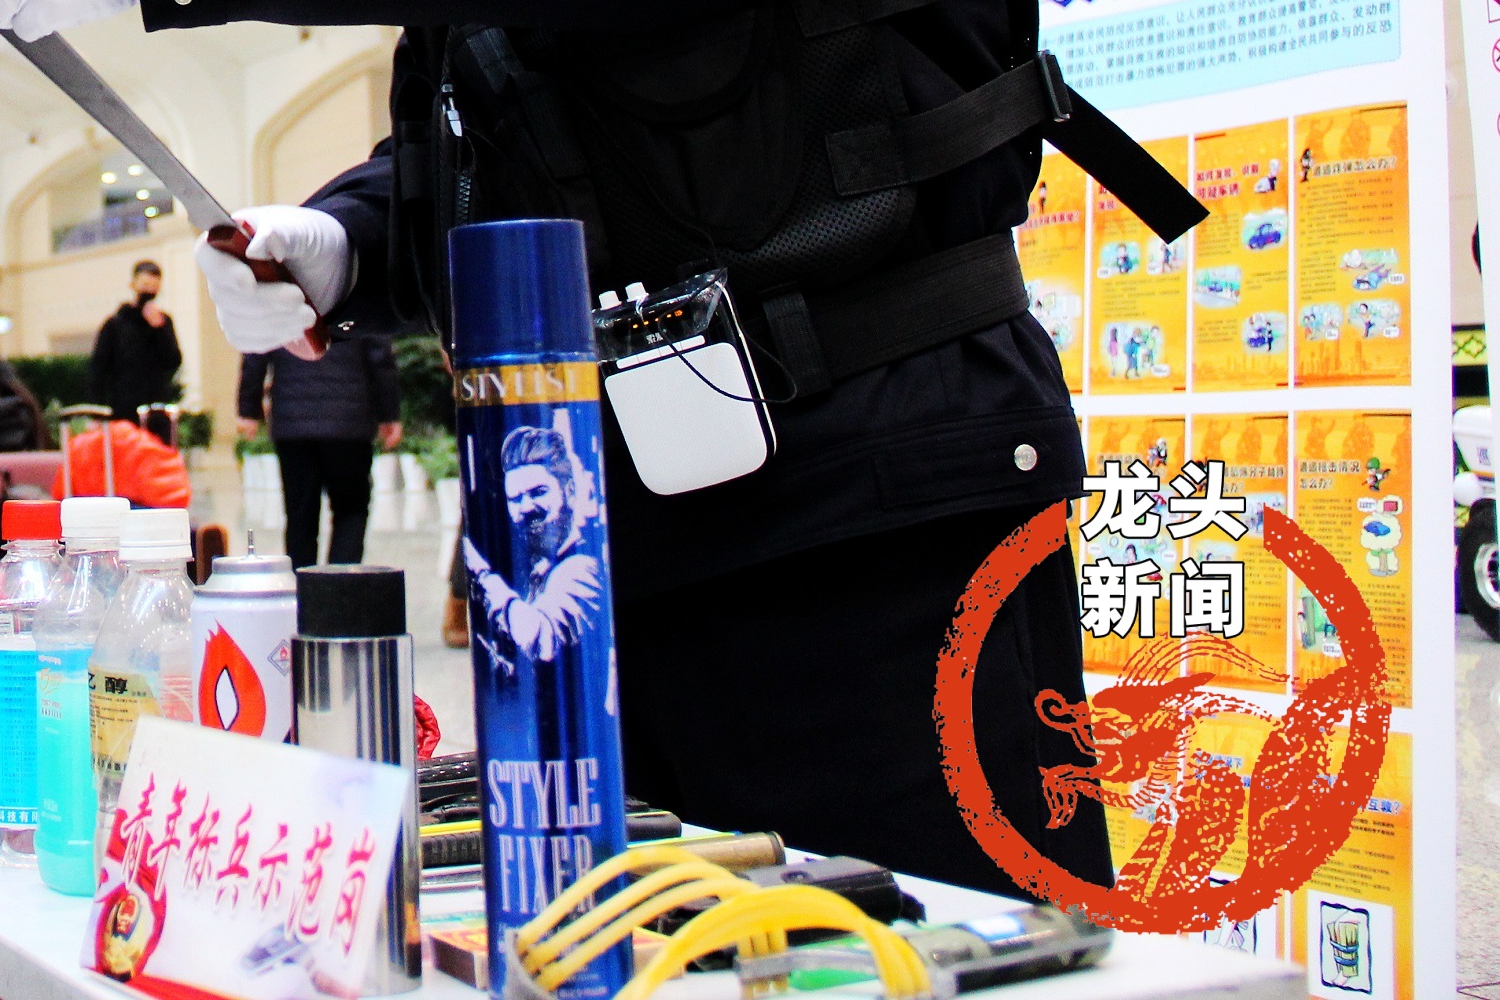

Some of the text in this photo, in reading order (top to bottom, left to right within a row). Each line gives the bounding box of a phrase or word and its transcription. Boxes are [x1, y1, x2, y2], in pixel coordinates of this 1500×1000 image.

[487, 757, 601, 829] STYLE
[119, 771, 376, 958] 青年标兵示范岗
[498, 833, 597, 914] FIXER
